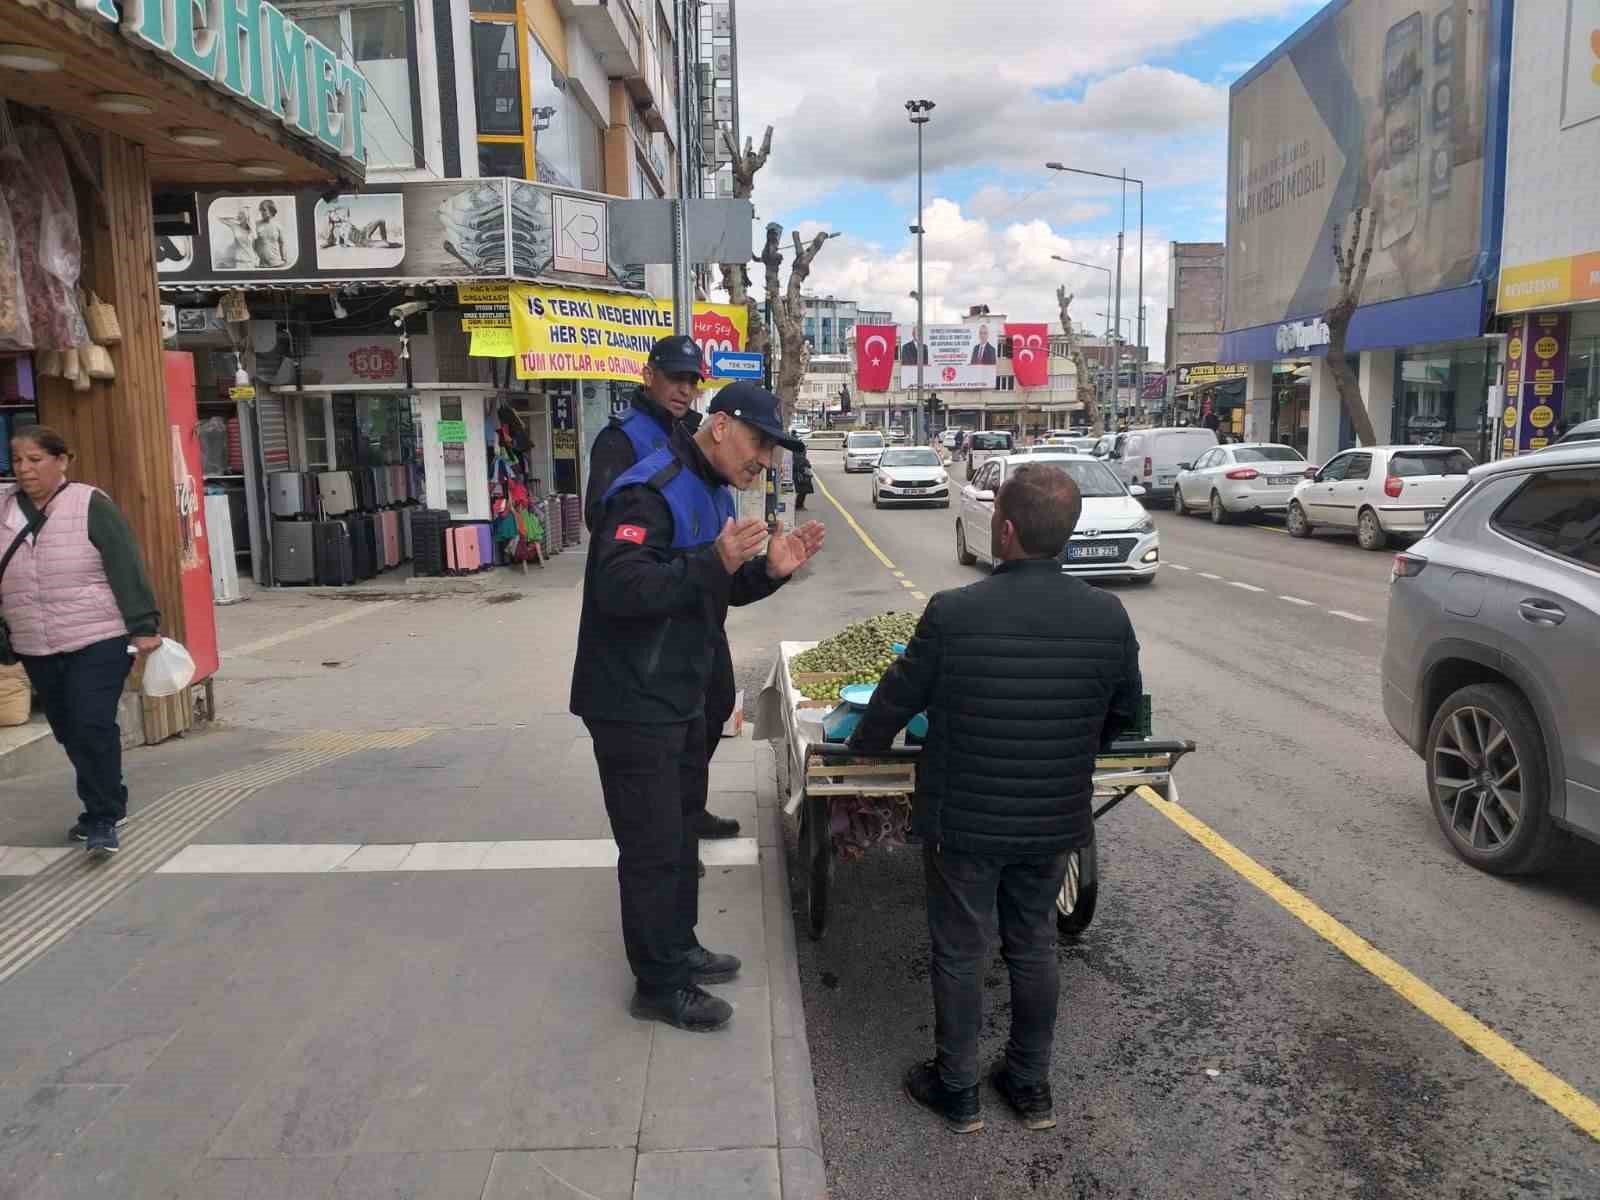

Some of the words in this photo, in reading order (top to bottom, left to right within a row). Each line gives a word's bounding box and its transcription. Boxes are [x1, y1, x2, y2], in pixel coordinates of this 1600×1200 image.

[548, 298, 593, 319] TERKİ
[597, 303, 672, 327] NEDENİYLE
[550, 325, 577, 343] HER
[521, 350, 546, 372] TÜM
[550, 353, 592, 374] KOTLAR
[595, 359, 606, 372] ve
